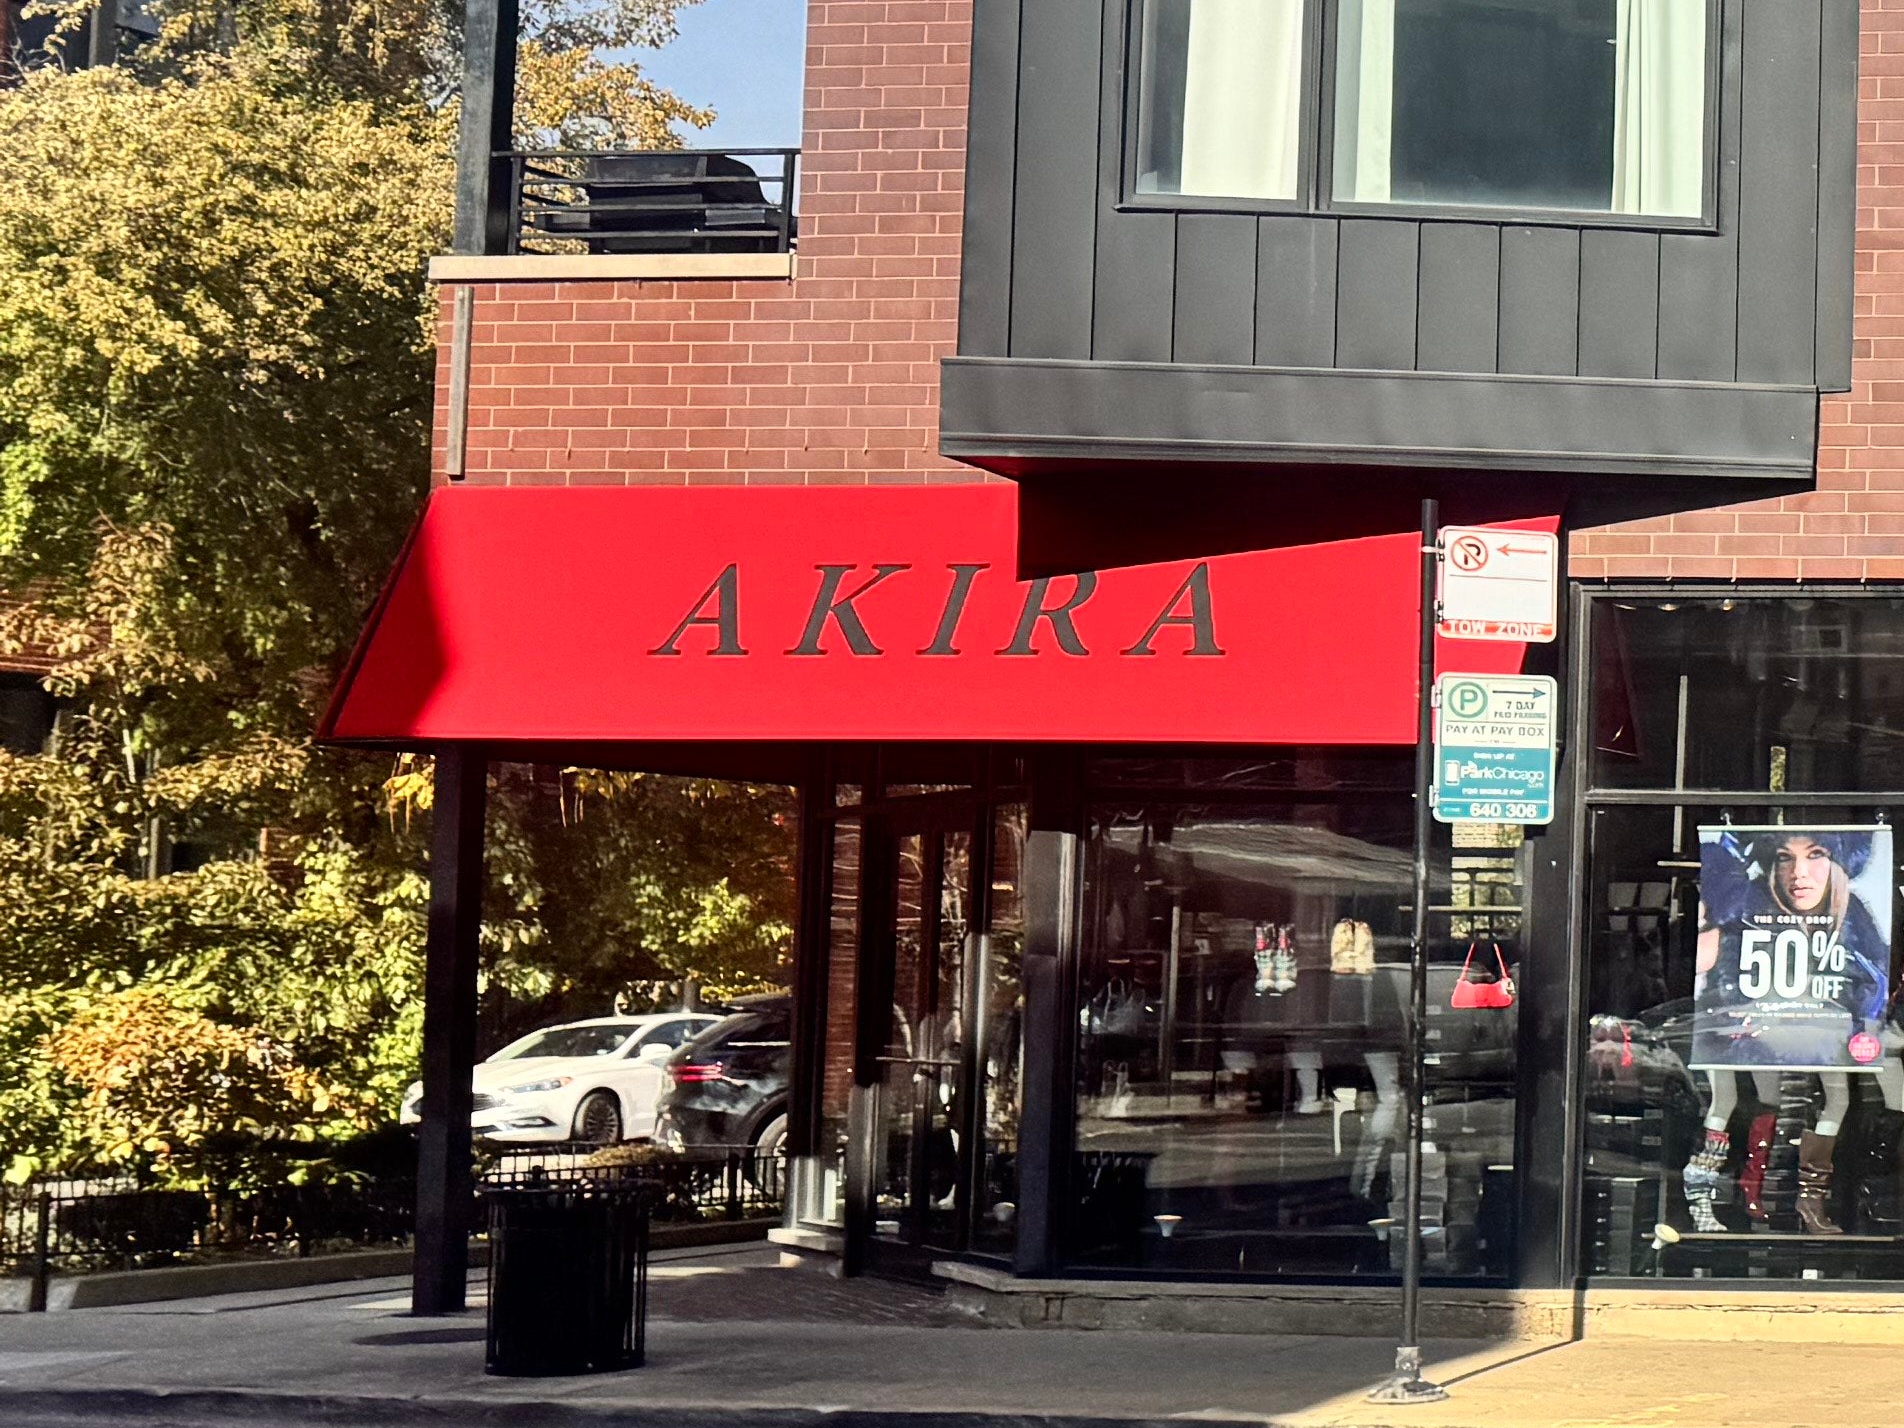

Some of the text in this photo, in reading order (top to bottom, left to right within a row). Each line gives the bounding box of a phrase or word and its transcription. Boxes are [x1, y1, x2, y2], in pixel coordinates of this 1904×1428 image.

[646, 561, 1226, 657] AKIRA
[1449, 620, 1546, 638] TOW ZONE
[1506, 700, 1536, 711] 7 DAY
[1446, 724, 1545, 737] PAY AT PAY BOX
[1460, 764, 1545, 784] ParkChicago
[1469, 802, 1501, 818] 640
[1738, 928, 1846, 999] 50%
[1811, 974, 1846, 1000] OFF
